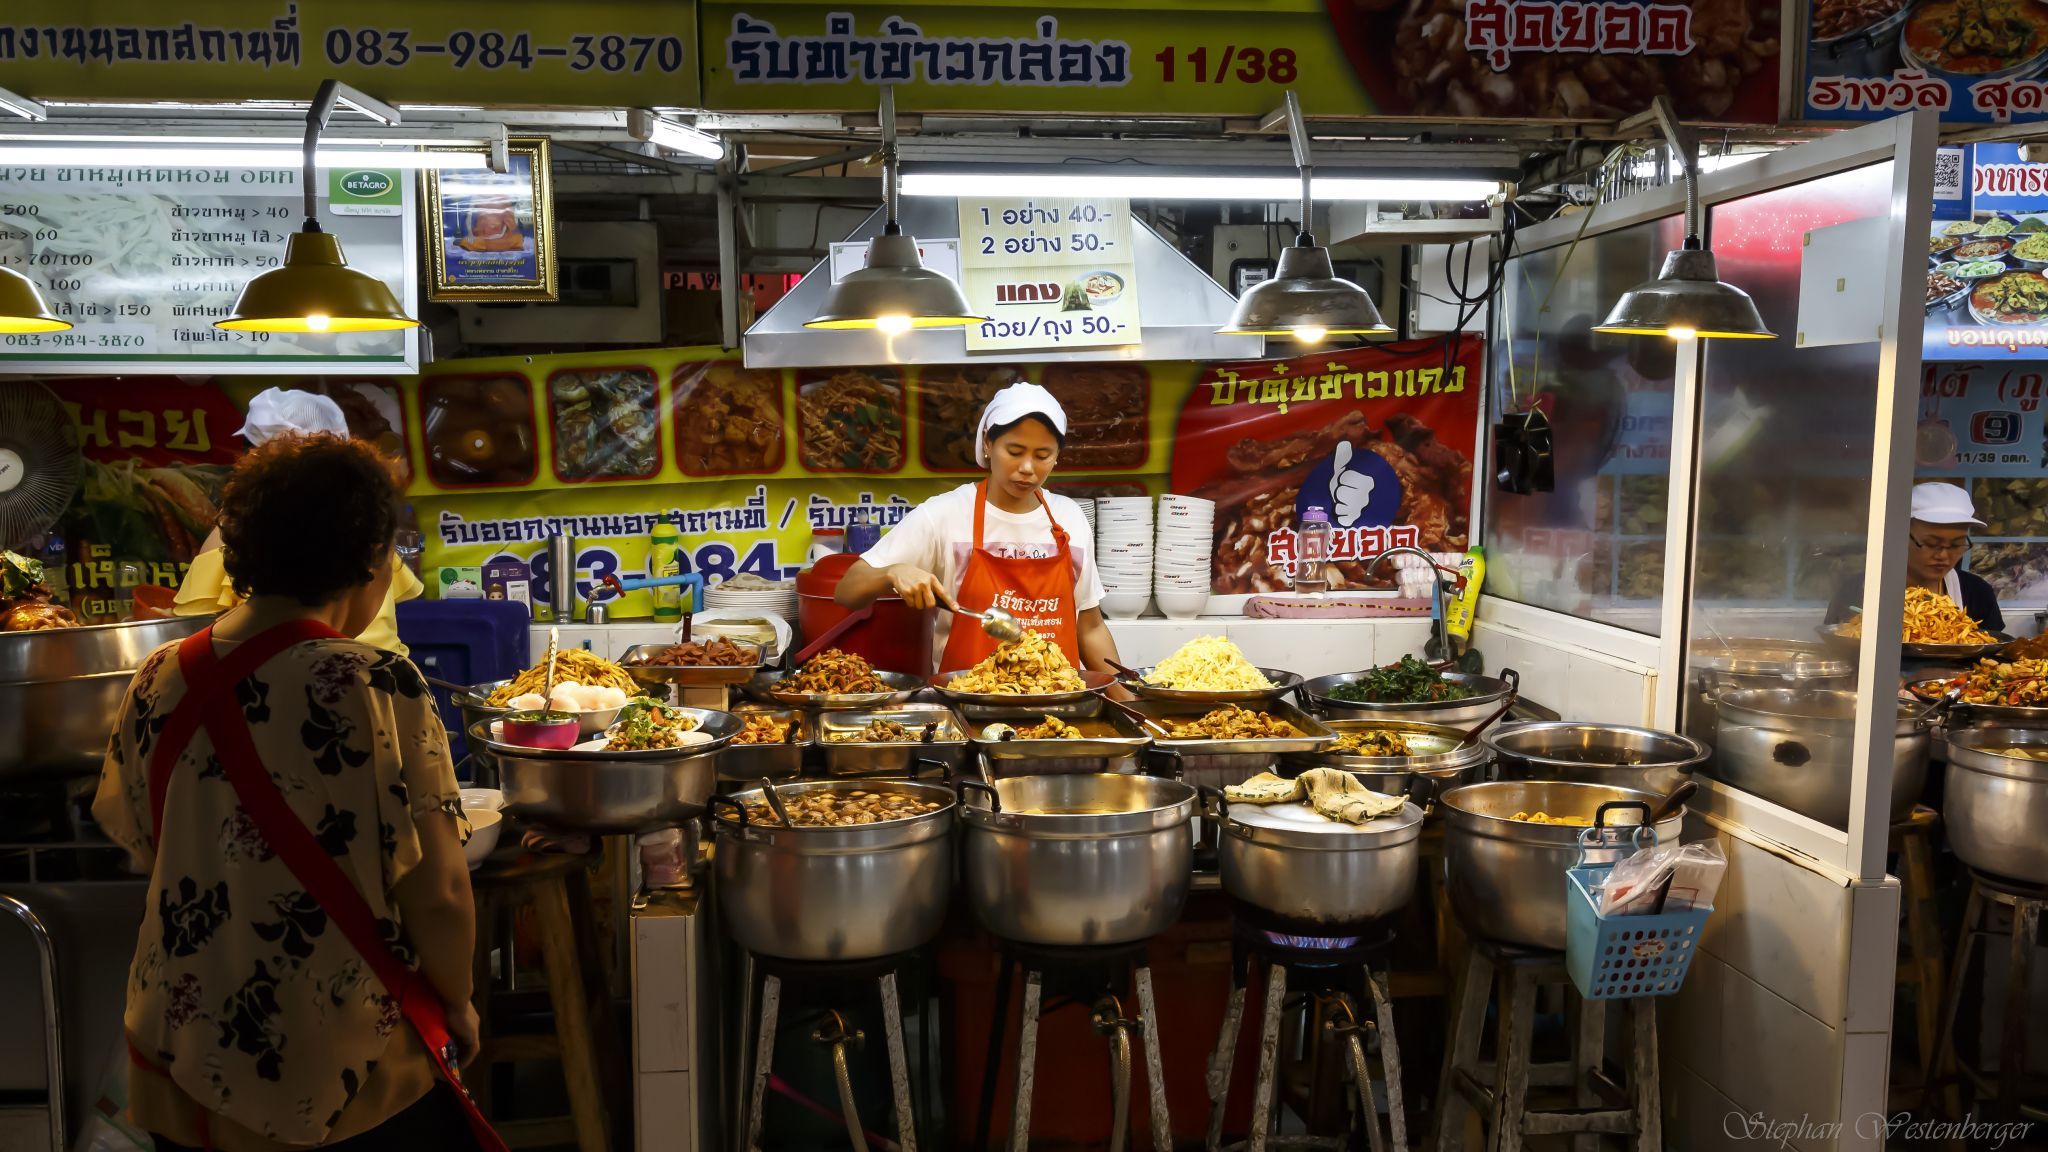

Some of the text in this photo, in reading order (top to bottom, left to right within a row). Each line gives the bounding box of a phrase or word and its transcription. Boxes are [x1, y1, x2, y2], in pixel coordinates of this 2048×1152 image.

[1468, 0, 1692, 68] สุดยอด
[326, 29, 683, 72] 083-984-3870
[730, 16, 1298, 83] รับทำข้าวกล่อง 11/38
[1812, 73, 2048, 118] รางวัล สุด
[57, 168, 229, 187] ขาหมูเหดหอม
[240, 170, 294, 184] อตก
[347, 181, 387, 189] BETAGRO
[1975, 167, 2048, 192] าหาร
[3, 204, 39, 216] 500
[171, 204, 245, 221] ข้าวขาหมู
[265, 206, 289, 218] 40
[980, 202, 1112, 225] 1 อย่าง 40.-
[35, 228, 58, 241] 60
[171, 228, 245, 246] ข้าวขาหมู
[981, 230, 1114, 254] 2 อย่าง 50.-
[28, 253, 93, 266] 70/100
[255, 255, 279, 267] 50
[49, 279, 81, 290] 100
[995, 283, 1061, 302] แกง
[119, 304, 151, 316] 150
[251, 330, 270, 342] 10
[981, 316, 1126, 342] ถ้วย/ถุง 50.-
[5, 334, 145, 347] 083-984-3870
[1210, 362, 1465, 415] ป้าตุ๋ยข้าวแกง
[1996, 367, 2048, 412] (ภู
[1956, 453, 1996, 464] 11/39
[1268, 527, 1416, 575] สุดยอด
[991, 589, 1060, 613] เจ๊หมวย
[1015, 614, 1062, 629] าหมูเห็ดหอม
